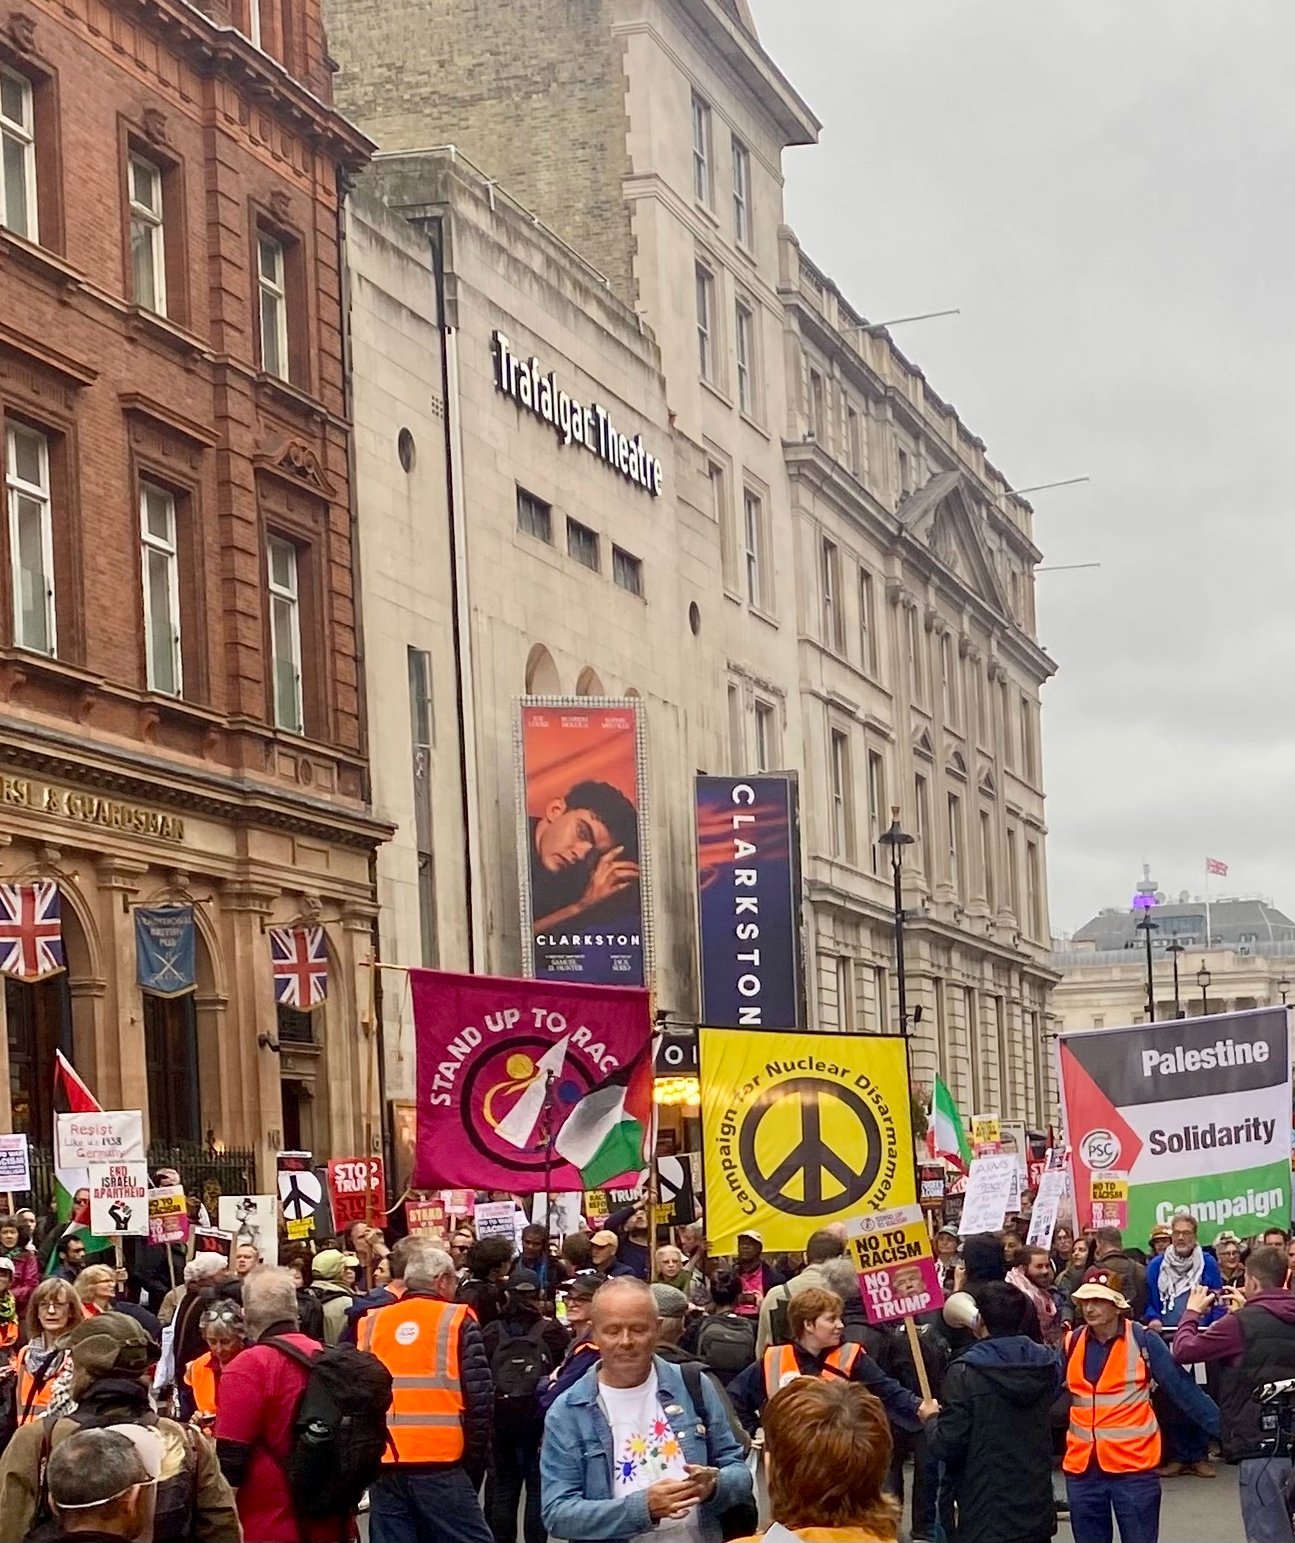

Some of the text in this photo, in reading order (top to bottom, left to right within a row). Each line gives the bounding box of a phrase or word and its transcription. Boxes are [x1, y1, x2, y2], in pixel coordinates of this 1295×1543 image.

[493, 330, 663, 497] Trafalgar Theatre
[62, 792, 185, 840] GUARDSMAN
[731, 784, 761, 1025] CLARKSTON
[536, 934, 640, 946] CLARKSTON
[430, 1007, 619, 1106] STAND UP TO RAC
[765, 1056, 851, 1078] Nuclear
[1141, 1038, 1270, 1077] Palestine
[733, 1074, 760, 1103] for
[70, 1124, 113, 1135] Resist
[1149, 1117, 1276, 1156] Solidarity
[853, 1074, 898, 1212] Disarmament
[1089, 1142, 1113, 1157] PSC
[109, 1166, 128, 1177] END
[715, 1108, 757, 1216] Campaign
[94, 1187, 145, 1198] APARTHEID
[101, 1176, 137, 1188] ISRAELI
[1092, 1182, 1116, 1191] NO TO
[610, 1188, 645, 1203] TRUM
[1092, 1191, 1123, 1200] RACISM
[1155, 1187, 1284, 1226] Campaign
[855, 1230, 905, 1254] NO TO
[859, 1240, 922, 1269] RACISM
[864, 1270, 890, 1290] NO
[867, 1286, 892, 1304] TO
[872, 1292, 931, 1319] TRUMP
